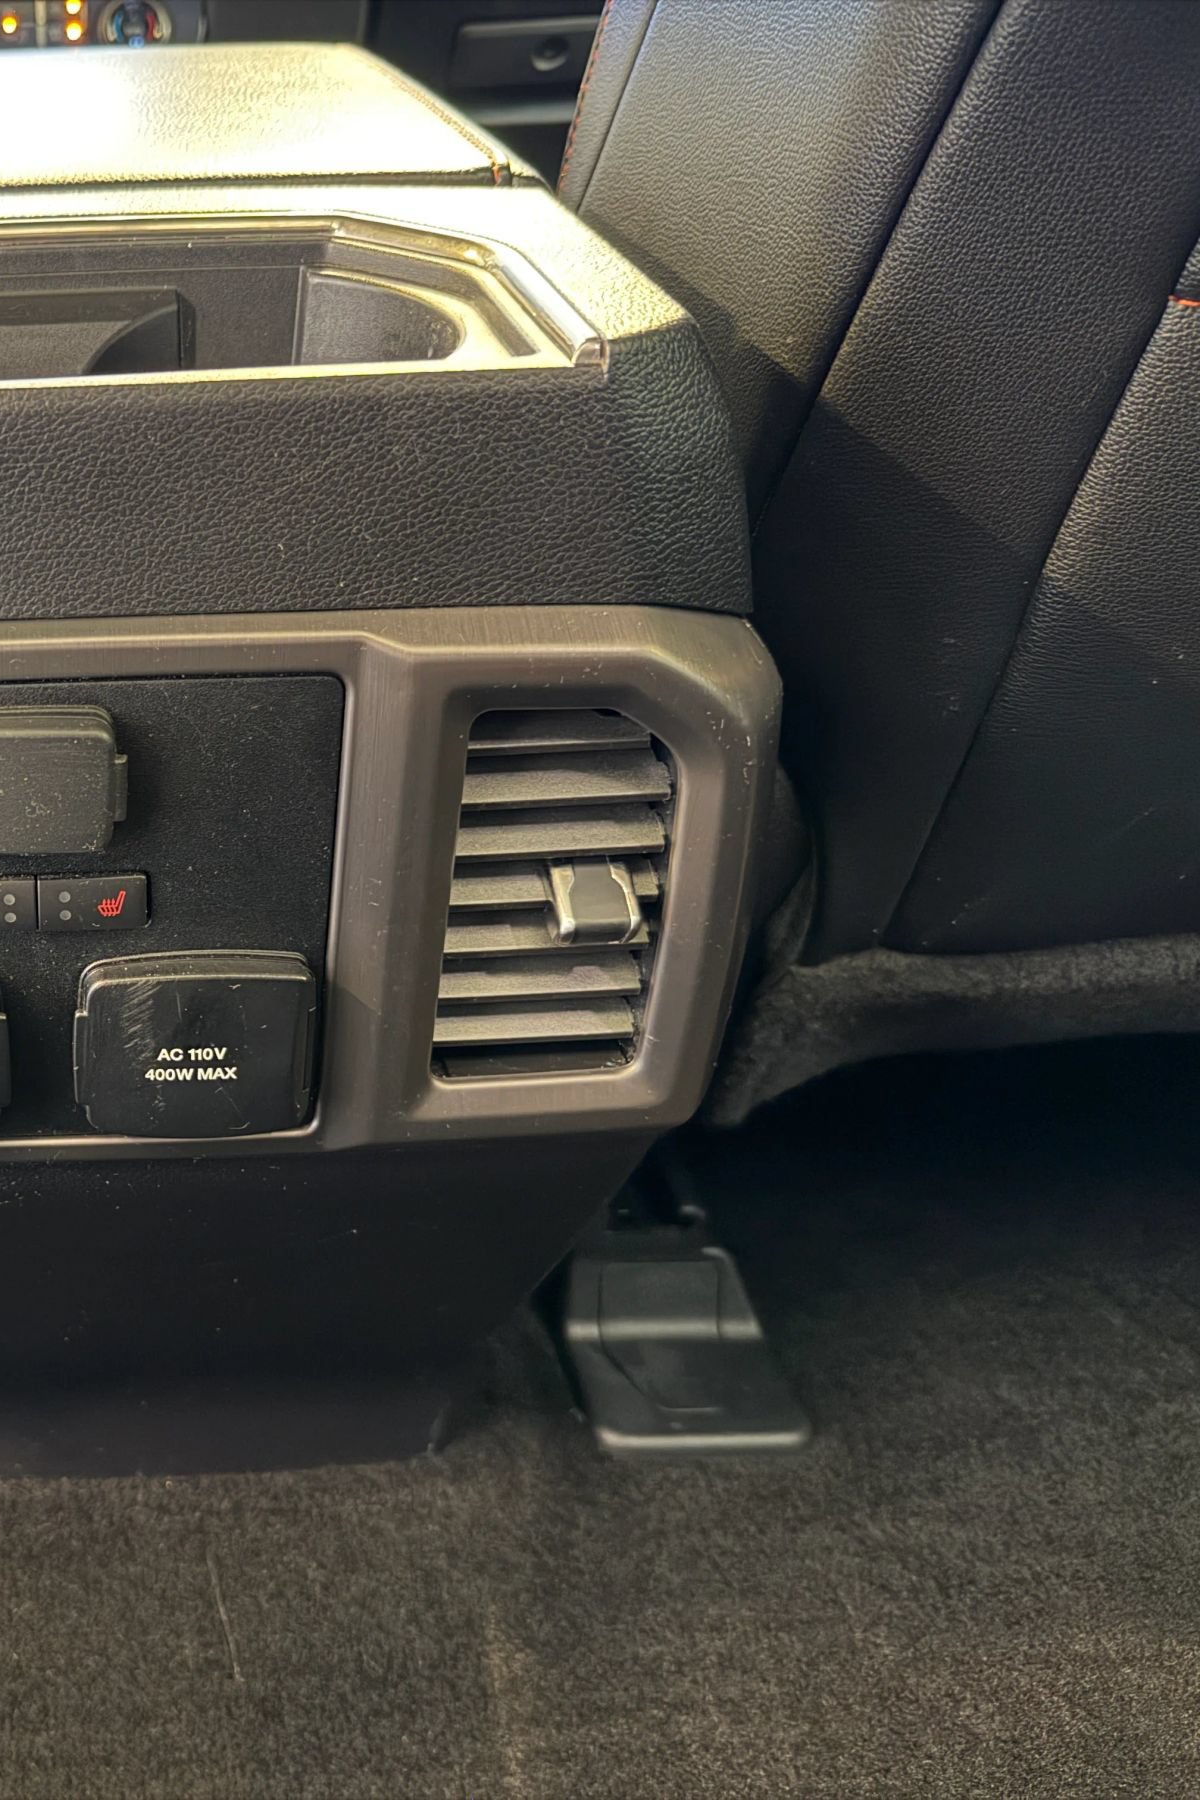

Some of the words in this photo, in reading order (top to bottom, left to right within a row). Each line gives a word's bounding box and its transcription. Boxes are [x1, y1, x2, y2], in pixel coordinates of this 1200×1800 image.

[157, 1048, 184, 1061] AC
[188, 1047, 227, 1061] 110V
[145, 1068, 194, 1081] 400W
[197, 1067, 237, 1080] MAX
